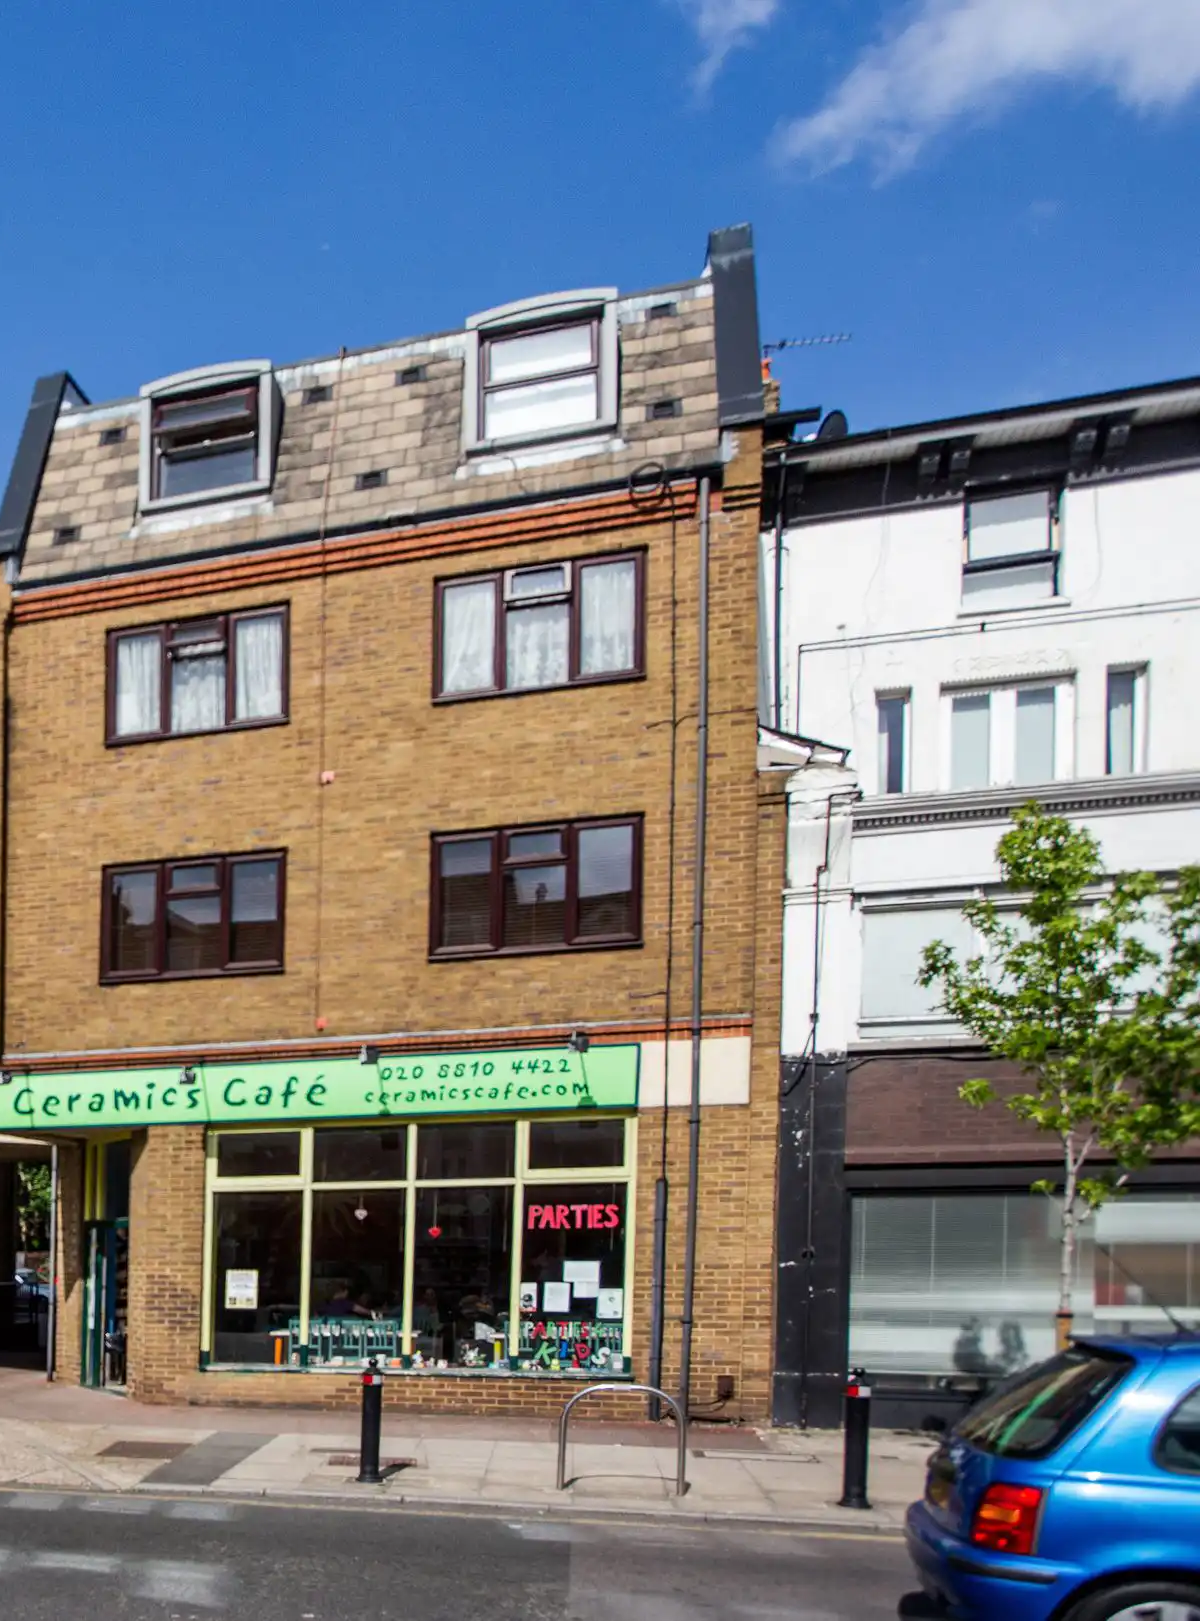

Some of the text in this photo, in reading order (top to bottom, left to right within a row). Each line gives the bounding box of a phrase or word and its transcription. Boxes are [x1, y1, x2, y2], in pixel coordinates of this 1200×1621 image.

[380, 1058, 572, 1081] 020 8810 4422
[12, 1074, 328, 1117] Ceramics Café
[364, 1082, 590, 1105] ceramicscafe.com
[527, 1203, 620, 1230] PARTIES
[523, 1320, 589, 1340] PARTIES
[533, 1341, 611, 1366] KIDS
